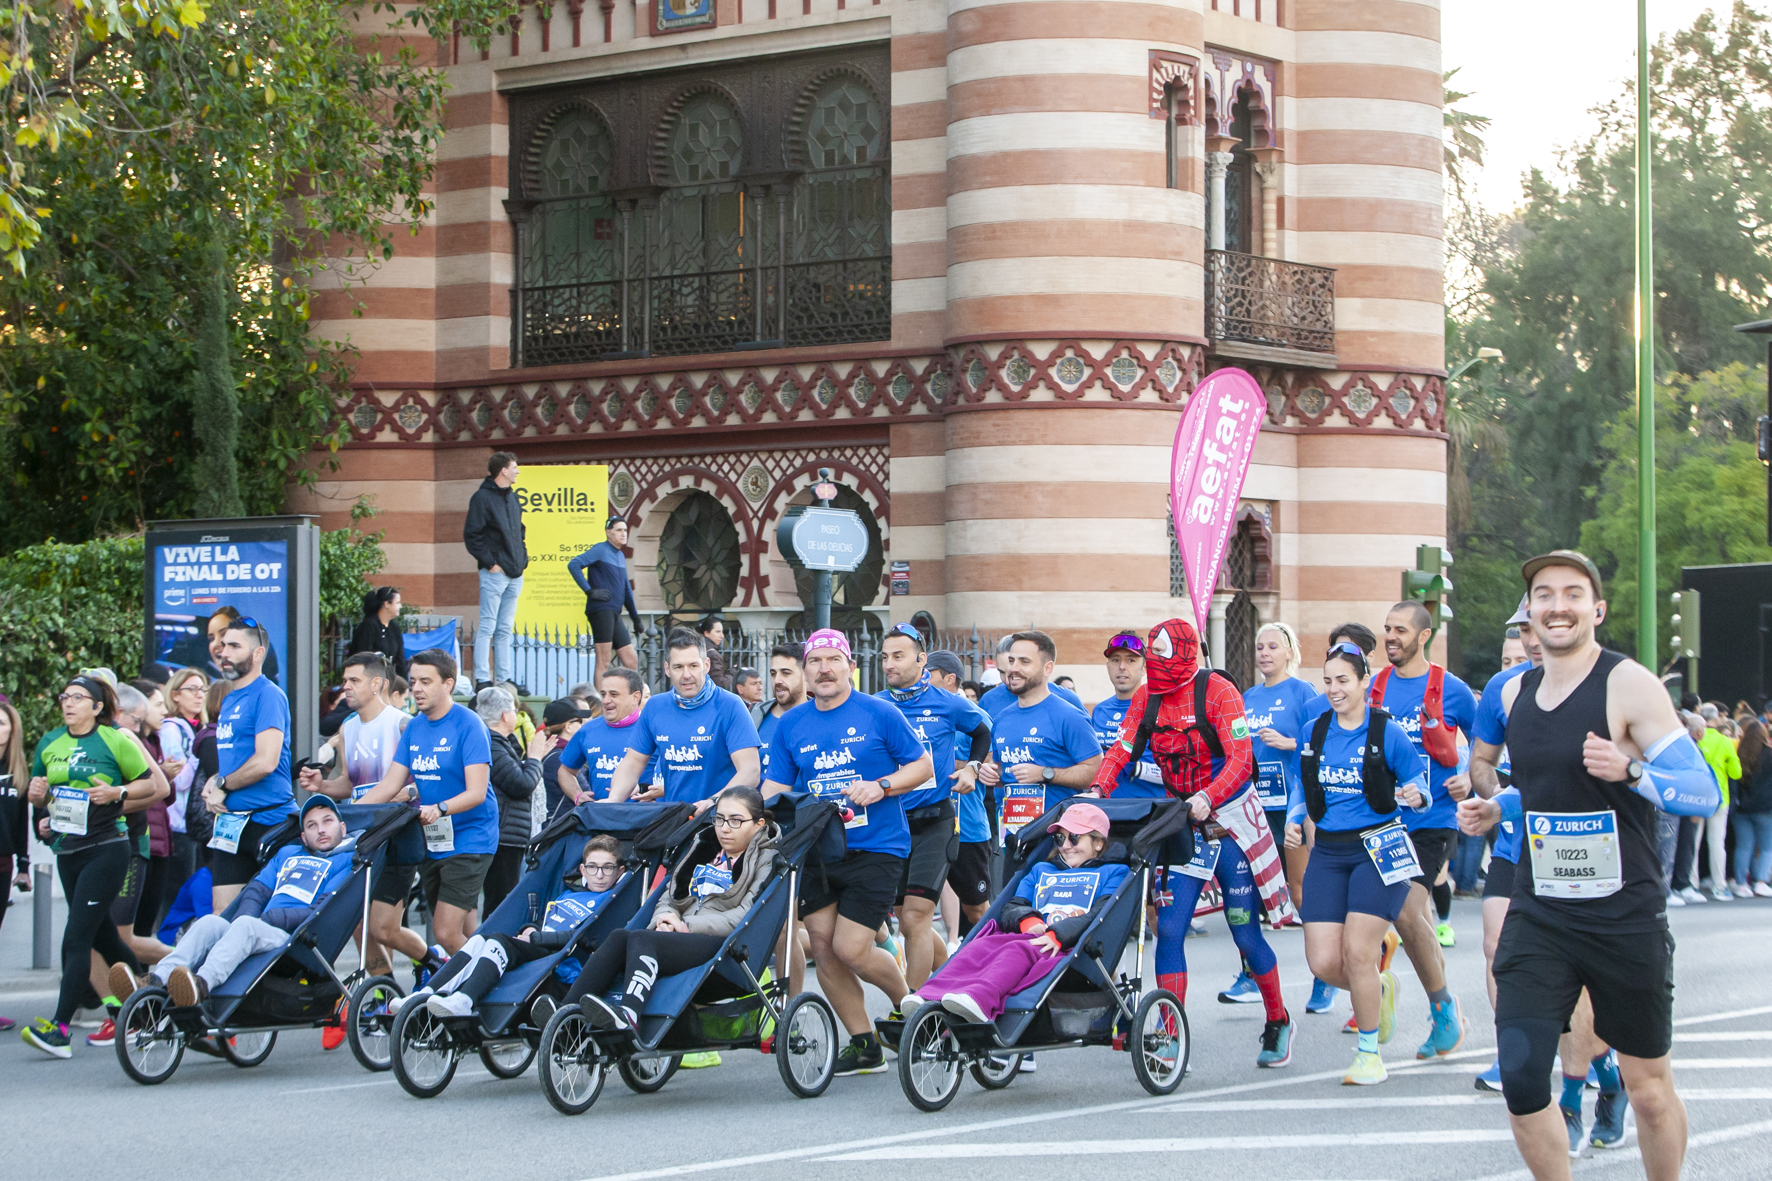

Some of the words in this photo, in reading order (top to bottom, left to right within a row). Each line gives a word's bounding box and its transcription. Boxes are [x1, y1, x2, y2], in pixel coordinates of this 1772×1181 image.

[1192, 394, 1244, 525] aefat
[1224, 481, 1241, 524] BIZUM
[1238, 455, 1248, 476] AL
[1244, 407, 1262, 453] 01274
[515, 487, 595, 507] Sevilla.
[821, 524, 840, 535] PASEO
[559, 544, 571, 552] So
[808, 540, 816, 550] DE
[818, 541, 828, 550] LAS
[828, 542, 853, 552] DELICIAS
[164, 546, 212, 564] VIVE
[214, 545, 240, 562] LA
[164, 564, 224, 582] FINAL
[226, 563, 252, 580] DE
[254, 562, 282, 580] OT
[164, 588, 185, 598] prime
[840, 736, 865, 744] ZURICH
[59, 790, 84, 799] ZURICH
[1677, 793, 1706, 806] ZURICH
[1554, 820, 1602, 832] ZURICH
[1555, 849, 1588, 860] 10223
[298, 859, 323, 868] ZURICH
[1190, 859, 1206, 867] ABEL
[1553, 867, 1596, 877] SEABASS
[1228, 884, 1253, 894] aefat
[563, 900, 586, 918] ZURICH
[626, 954, 658, 1002] FILA
